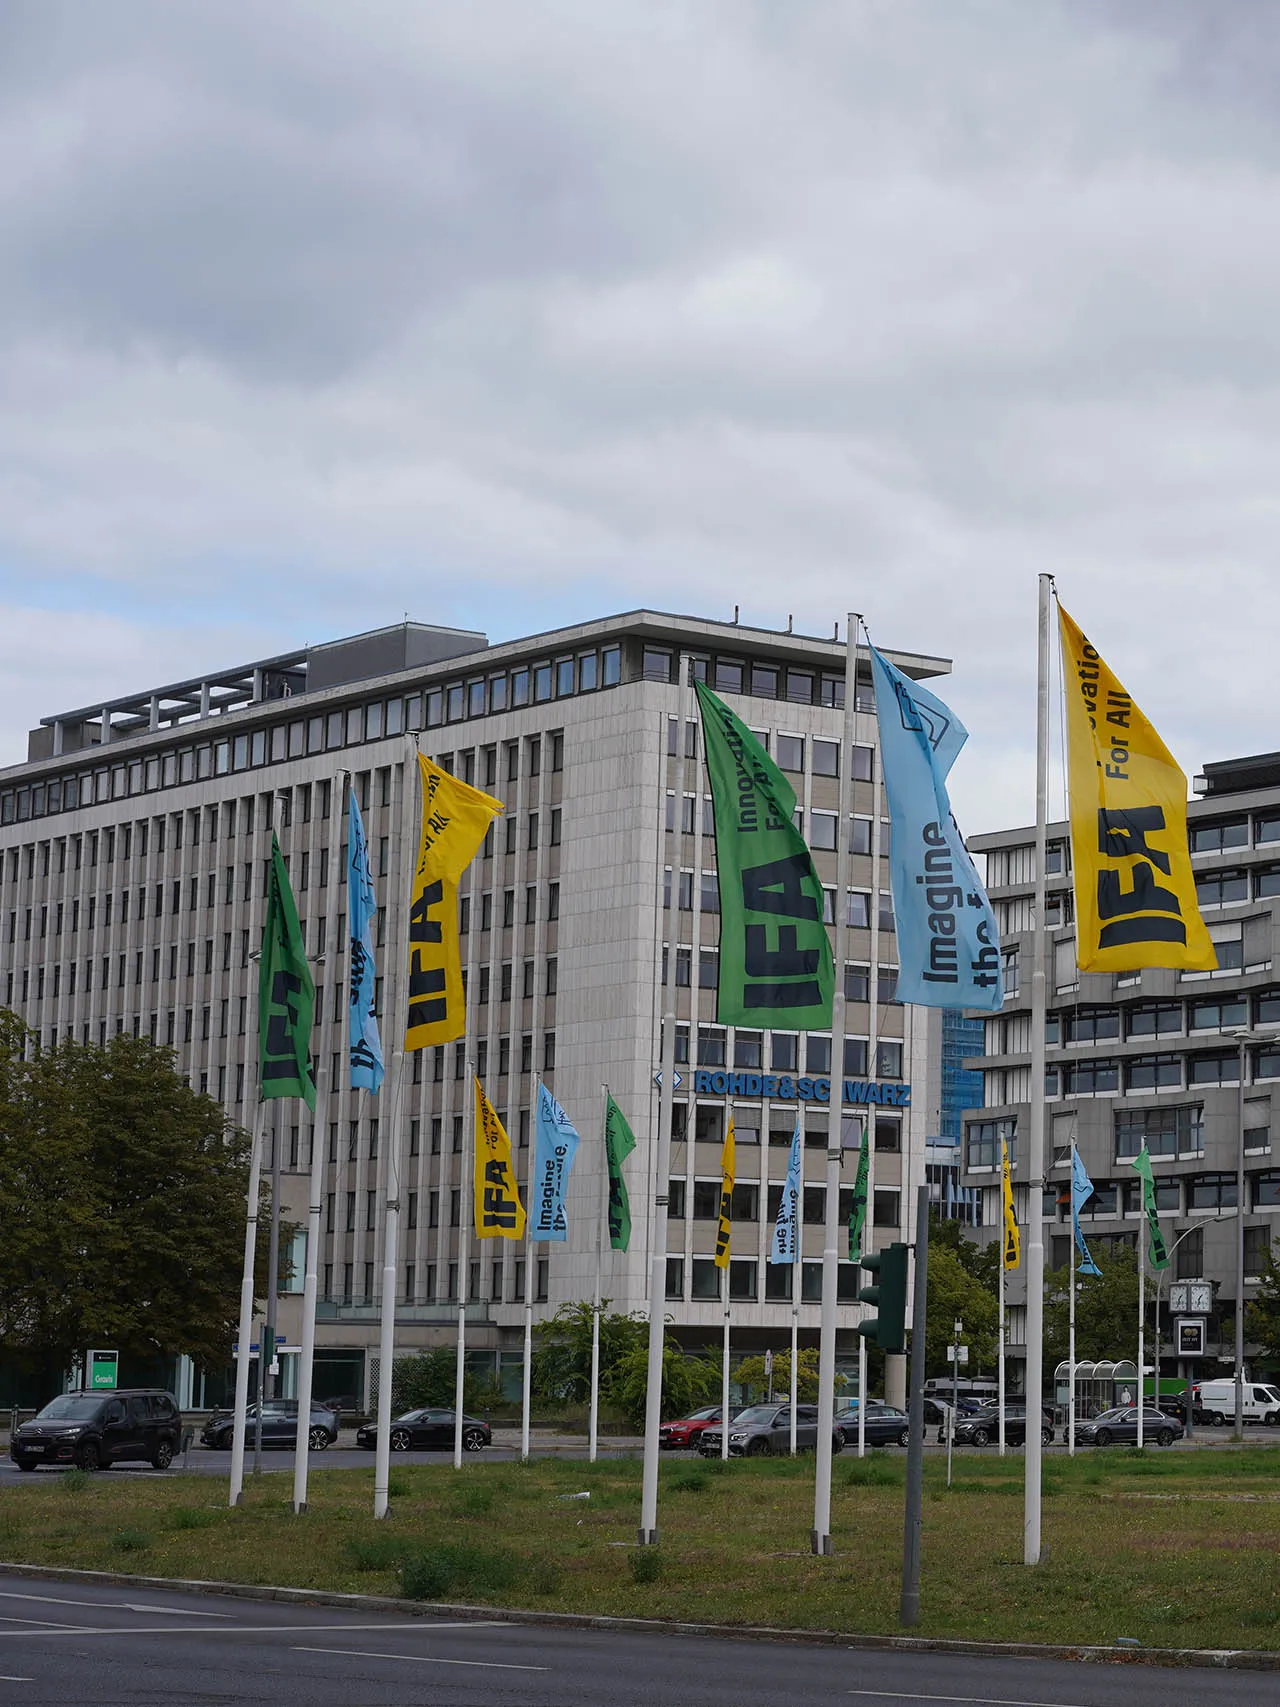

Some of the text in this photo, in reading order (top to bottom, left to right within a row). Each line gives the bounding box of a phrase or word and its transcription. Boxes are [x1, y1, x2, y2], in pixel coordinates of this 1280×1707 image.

[720, 707, 758, 832] Innovati
[1106, 690, 1131, 780] For All
[741, 852, 823, 1008] IFA
[916, 820, 963, 984] Imagine
[1098, 805, 1187, 949] IFA
[407, 879, 447, 1029] IFA
[483, 1159, 518, 1229] IFA
[537, 1160, 555, 1231] Imagine
